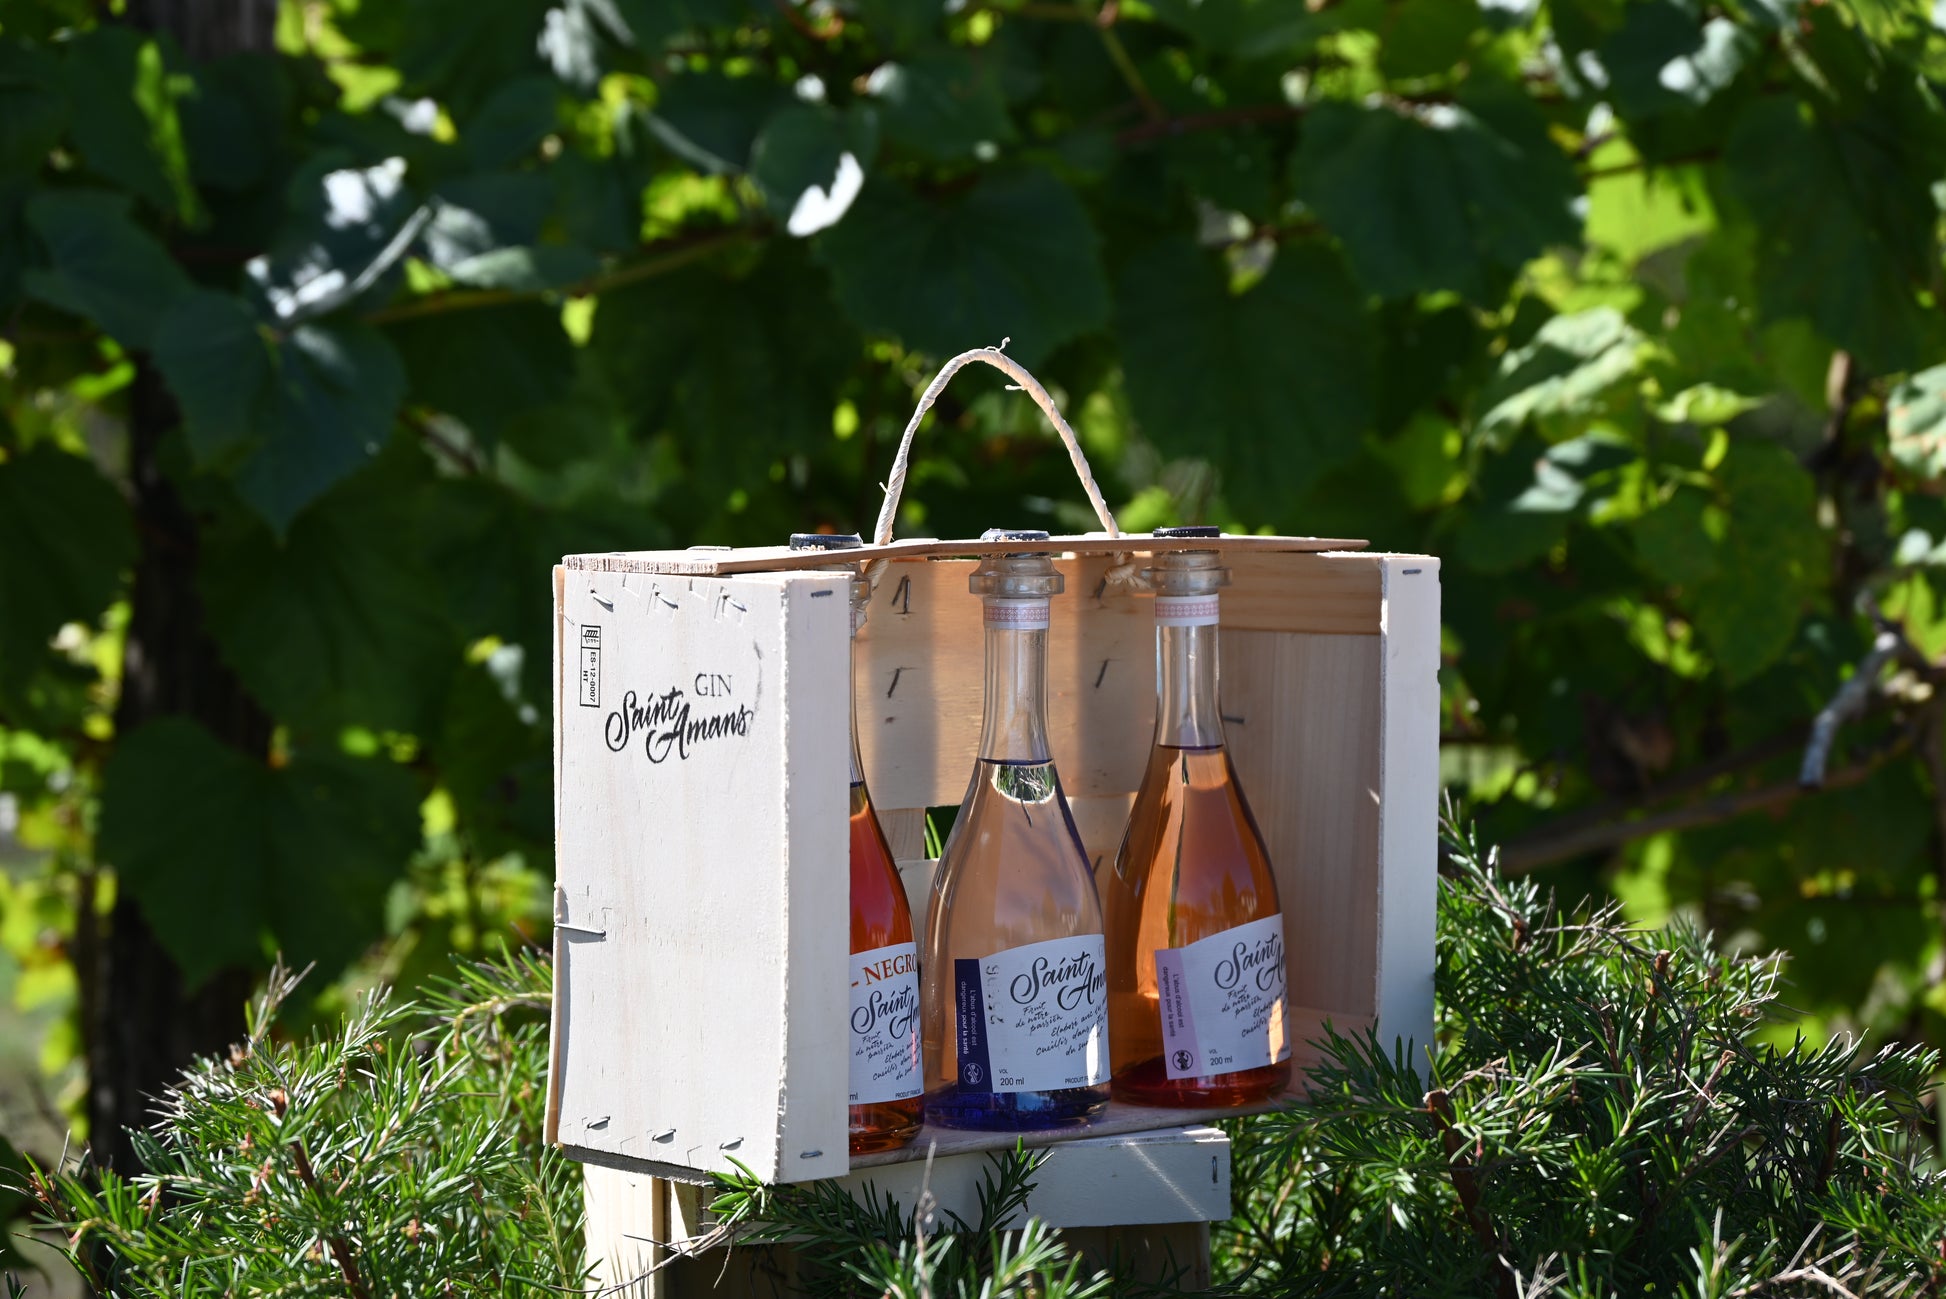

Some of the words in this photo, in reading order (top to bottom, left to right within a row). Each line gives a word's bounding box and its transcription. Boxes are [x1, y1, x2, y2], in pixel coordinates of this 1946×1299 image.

[583, 670, 588, 682] HT
[589, 651, 597, 703] ES-12-0007
[694, 672, 733, 697] GIN
[605, 685, 684, 752] Saint
[645, 702, 754, 764] Amans
[1214, 932, 1278, 990] Saint
[1010, 951, 1090, 1004] Saint
[850, 985, 912, 1035] Saint
[1023, 1001, 1046, 1015] Fruit
[1015, 1018, 1025, 1028] de
[1030, 1014, 1063, 1036] passion
[1210, 1056, 1223, 1066] 200
[1224, 1055, 1233, 1064] ml
[1000, 1077, 1014, 1086] 200
[1015, 1077, 1025, 1085] ml
[1064, 1076, 1083, 1085] PRODUIT
[849, 1093, 858, 1101] ml
